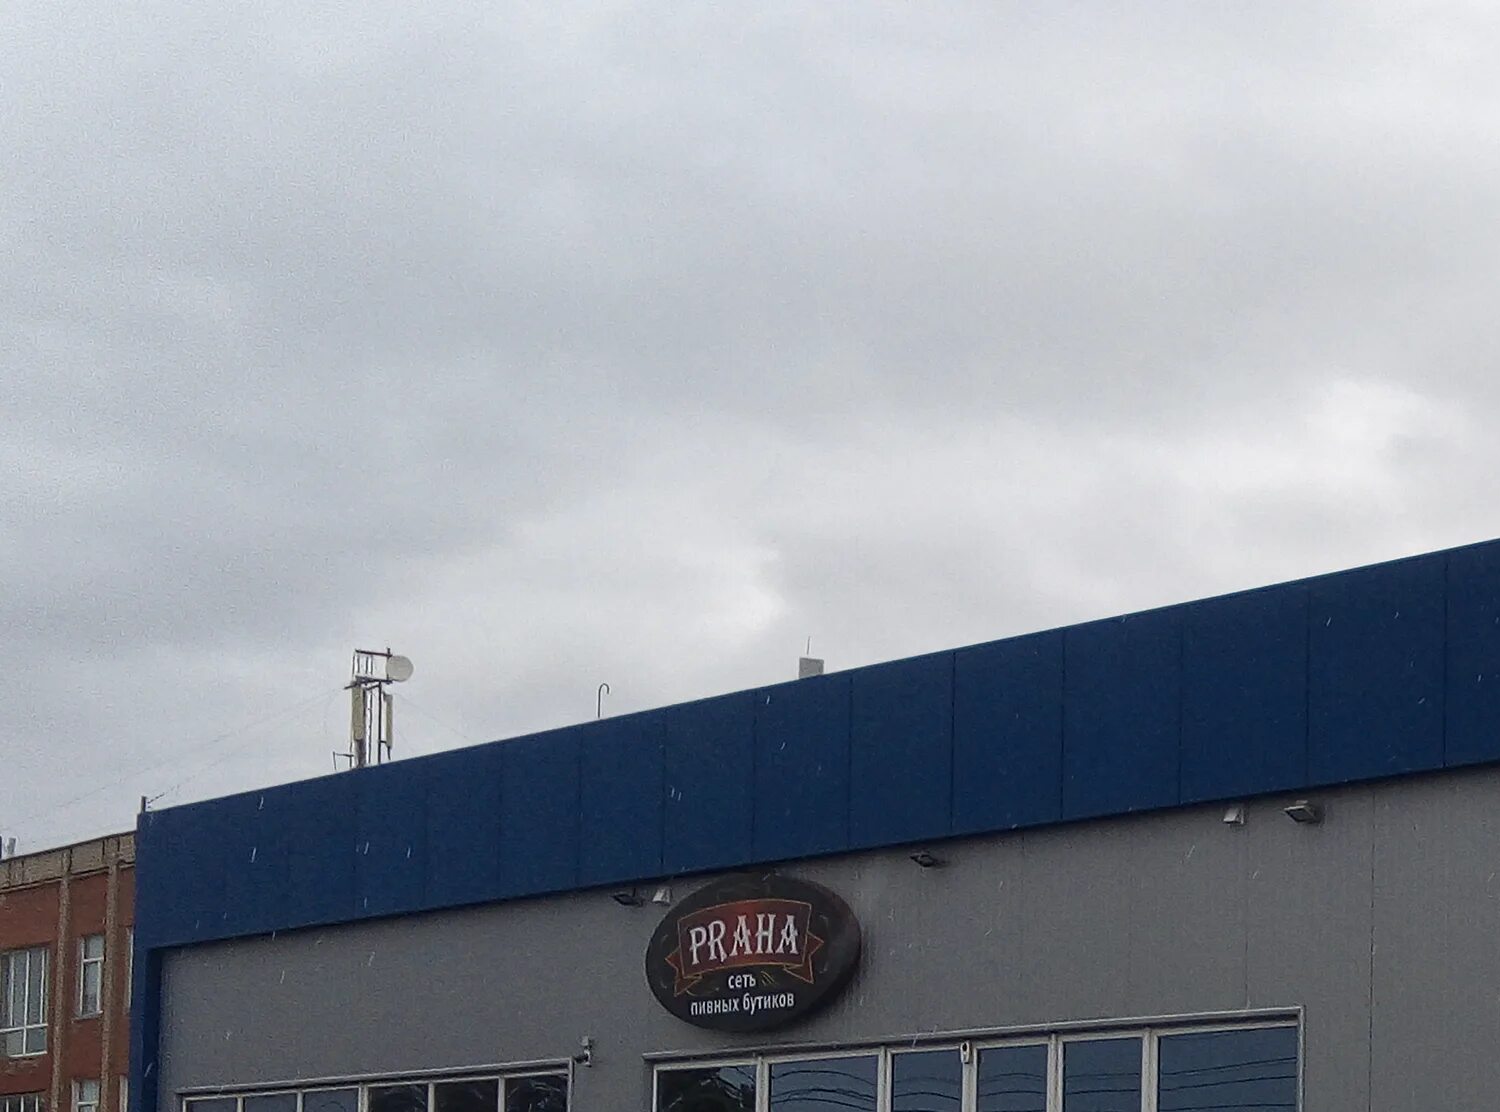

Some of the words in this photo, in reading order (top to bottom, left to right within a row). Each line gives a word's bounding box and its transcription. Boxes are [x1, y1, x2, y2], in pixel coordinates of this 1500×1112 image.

[690, 913, 799, 965] PRAHA
[728, 973, 756, 989] сеть
[691, 998, 740, 1016] пивных
[742, 993, 795, 1016] бутиков
